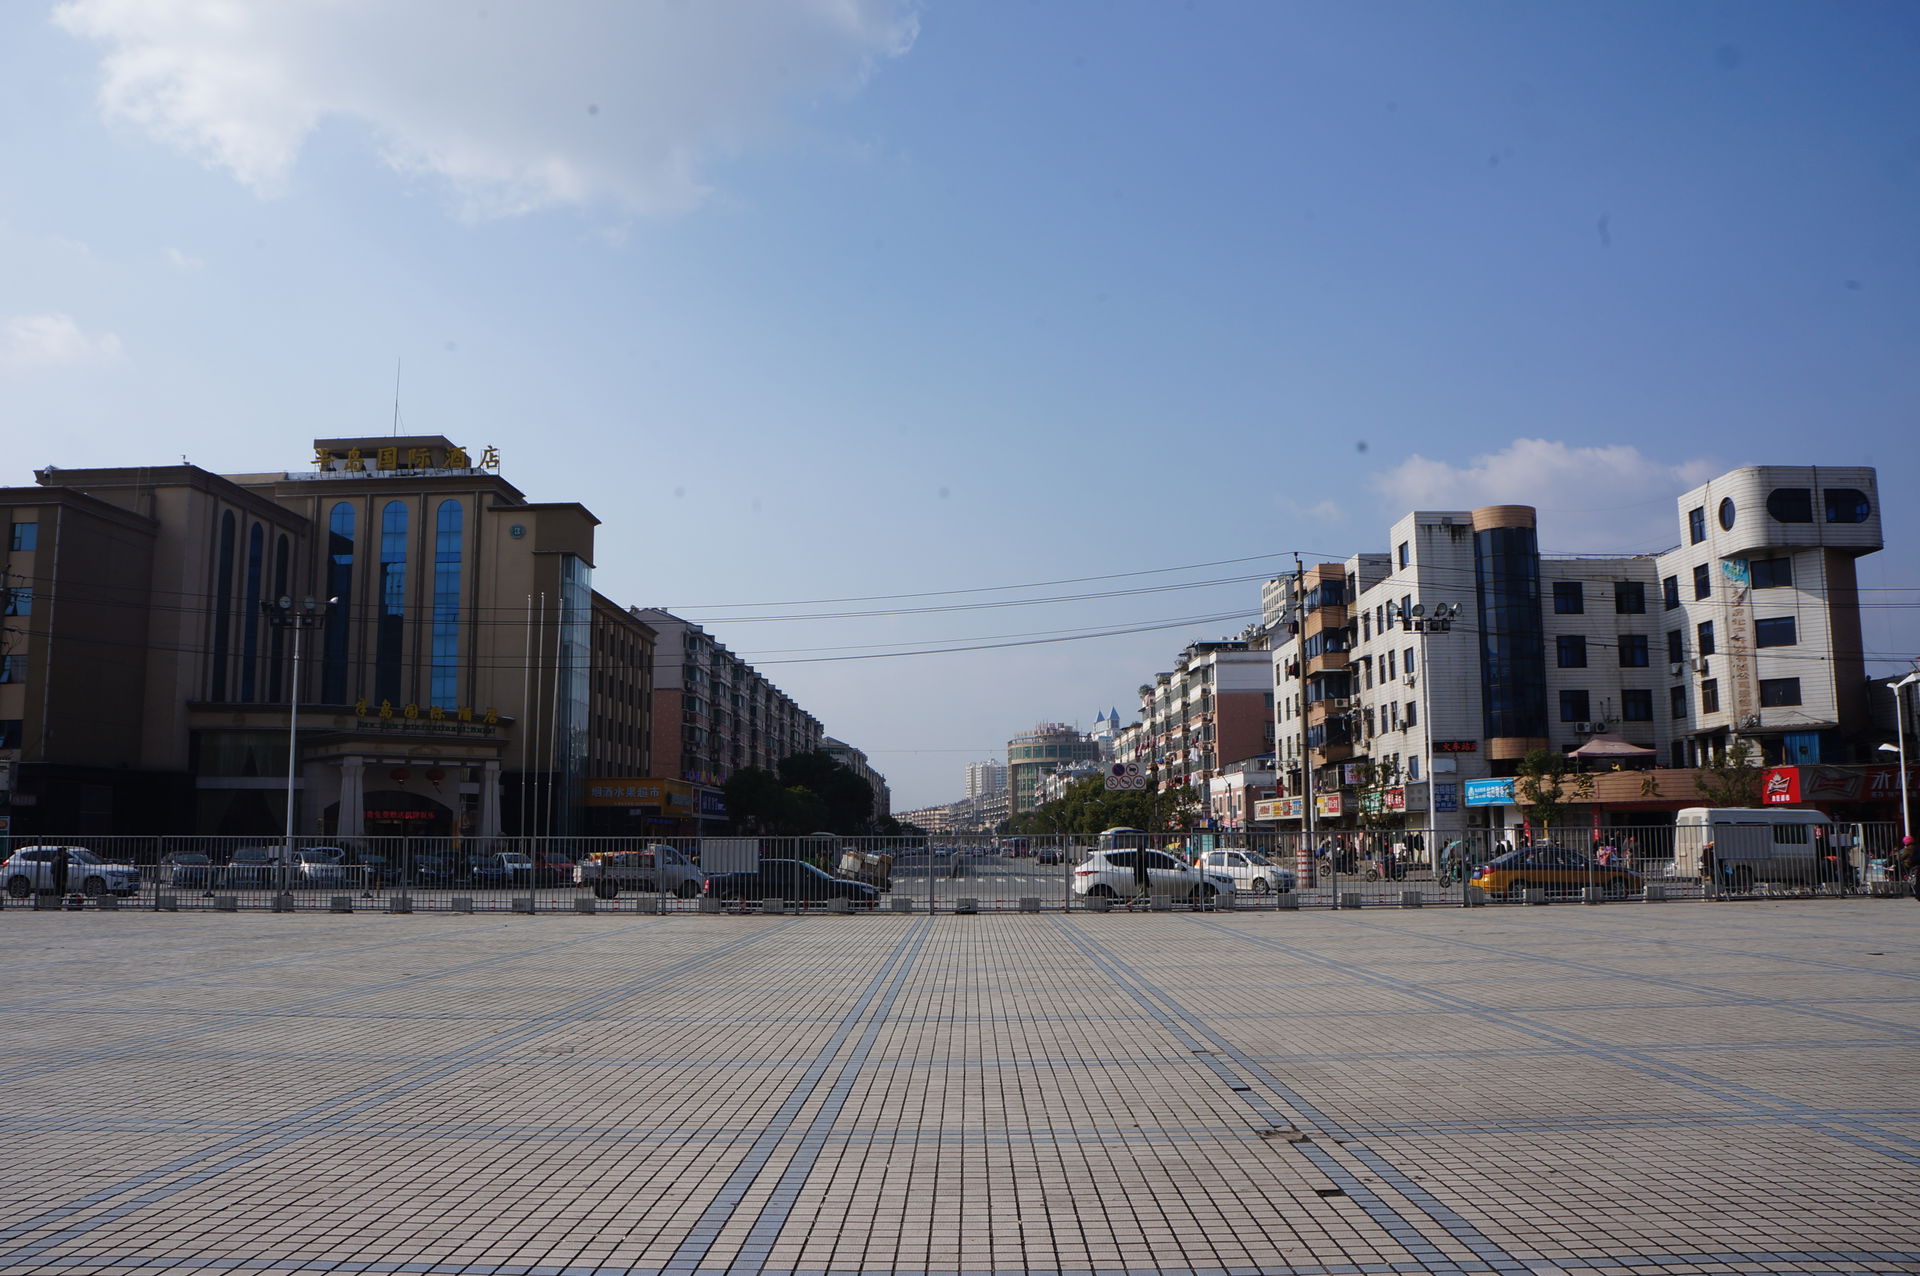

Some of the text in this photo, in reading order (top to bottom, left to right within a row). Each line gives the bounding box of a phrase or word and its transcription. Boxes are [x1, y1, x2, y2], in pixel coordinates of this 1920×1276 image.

[310, 445, 500, 472] 半岛国际酒店
